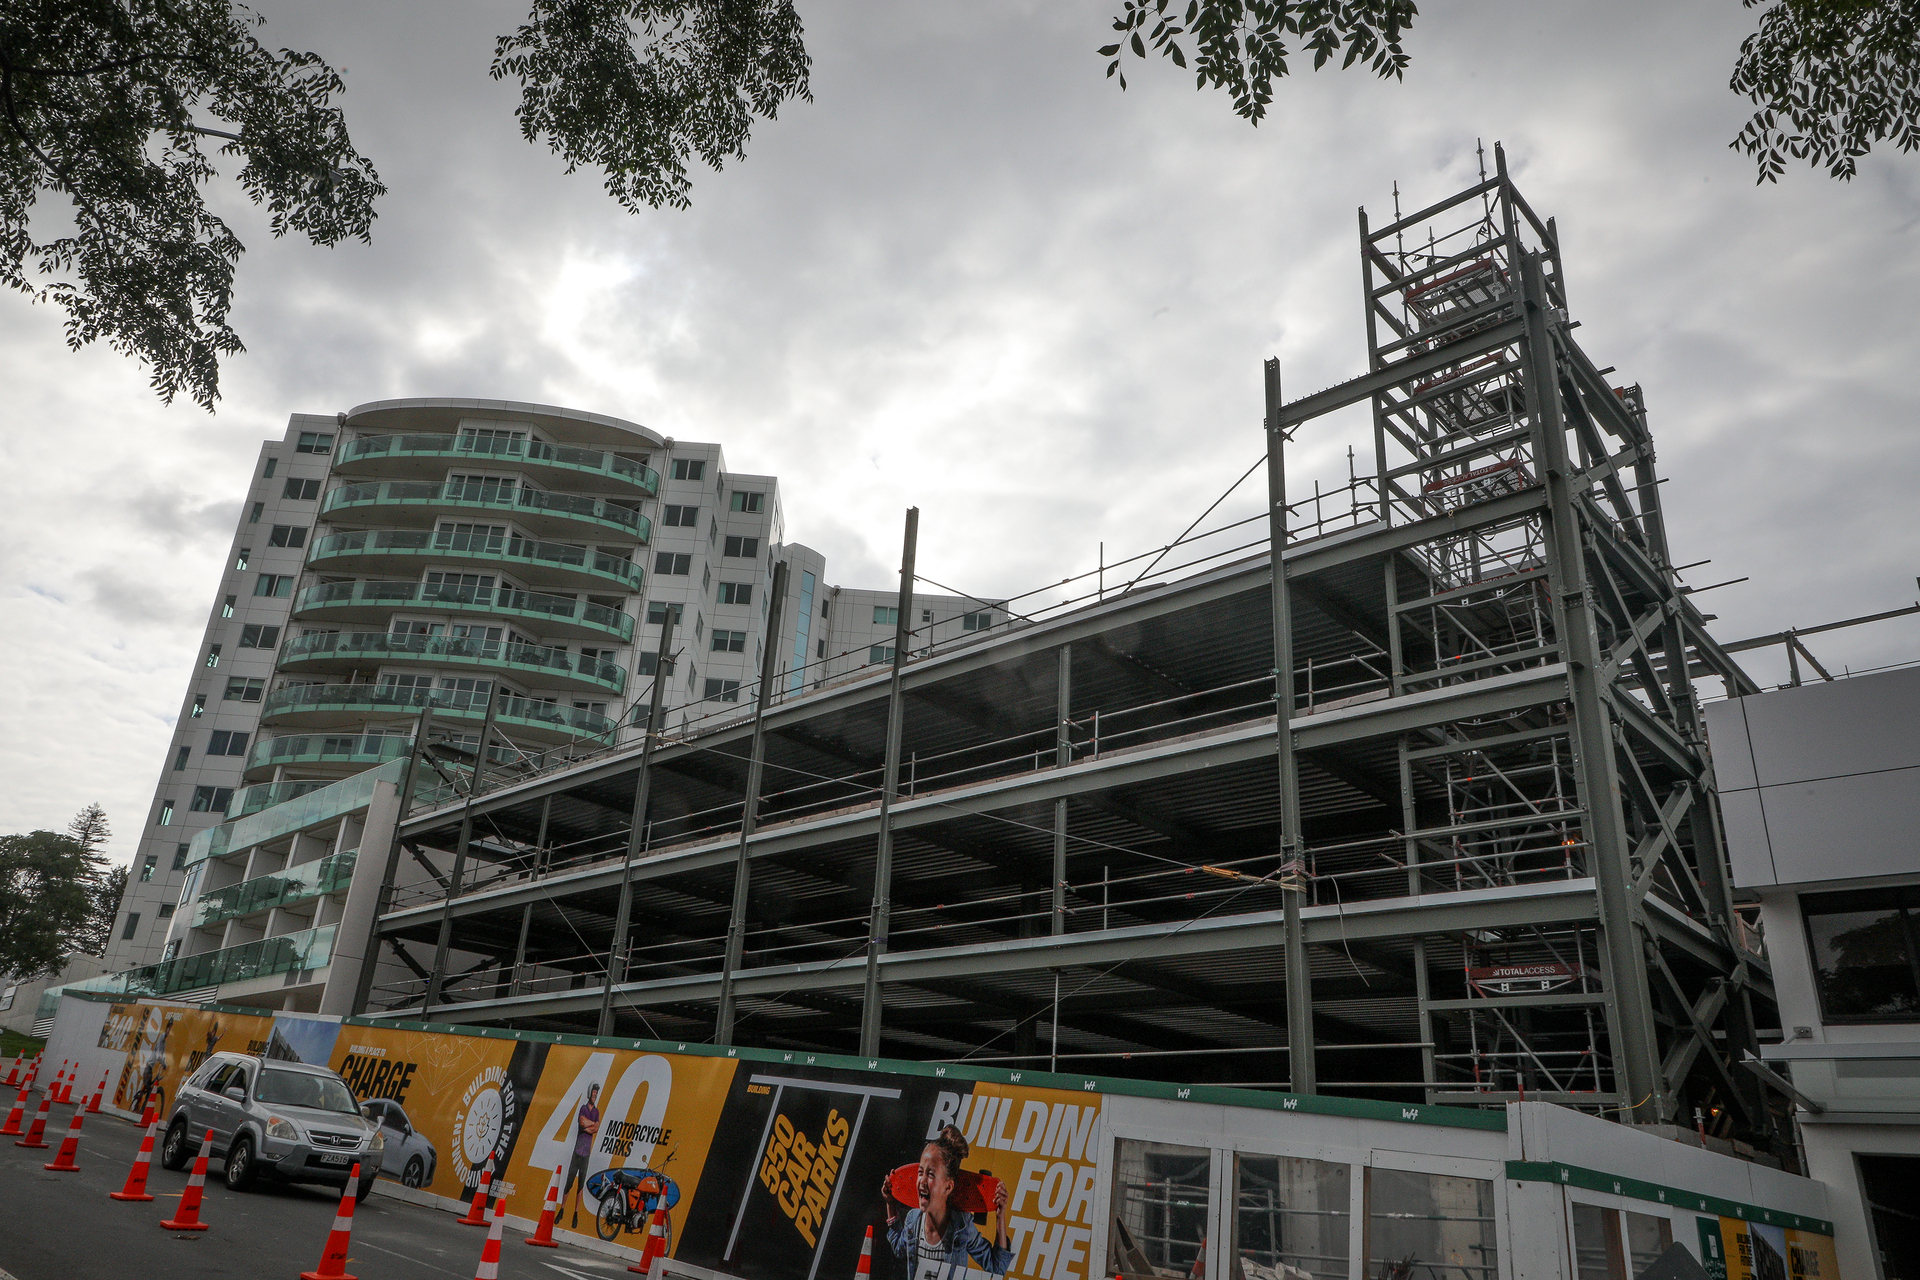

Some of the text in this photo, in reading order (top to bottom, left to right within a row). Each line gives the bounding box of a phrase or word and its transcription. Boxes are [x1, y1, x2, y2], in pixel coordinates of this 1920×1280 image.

[339, 1054, 417, 1105] CHARGE
[462, 1066, 507, 1107] BUILDING
[503, 1080, 515, 1118] FOR
[747, 1084, 770, 1095] BUILDING
[495, 1122, 513, 1161] THE
[528, 1052, 672, 1219] 40
[600, 1137, 633, 1157] PARKS
[605, 1120, 672, 1146] MOTORCYCLE
[760, 1114, 795, 1195] 550
[778, 1132, 817, 1219] CAR
[795, 1109, 849, 1249] PARKS
[1011, 1158, 1097, 1224] FOR
[1006, 1216, 1092, 1280] THE
